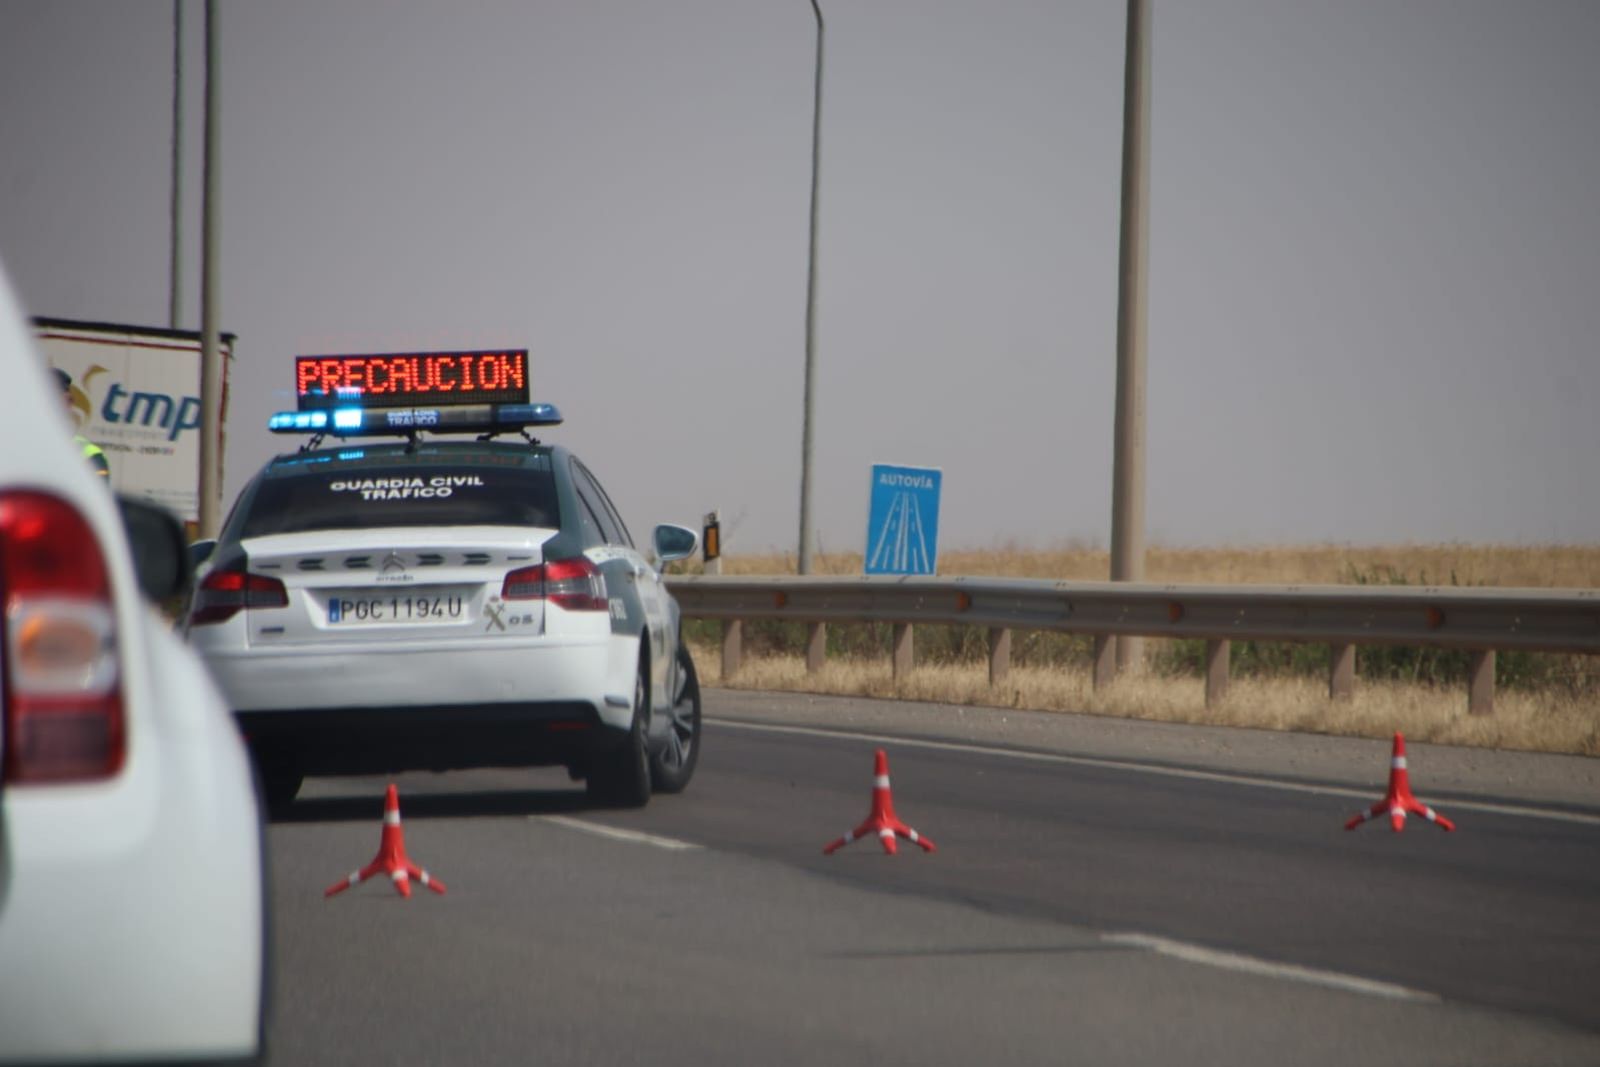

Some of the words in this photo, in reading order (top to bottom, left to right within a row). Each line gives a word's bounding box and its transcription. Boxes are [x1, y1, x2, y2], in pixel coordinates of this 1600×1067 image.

[298, 355, 522, 394] PRECAUCION
[102, 383, 202, 441] tmp
[330, 478, 424, 491] GUARDIA
[430, 476, 484, 487] CIVIL
[880, 473, 933, 488] AUTOVÍA
[361, 487, 453, 500] TRAFICO
[341, 601, 382, 621] PGC
